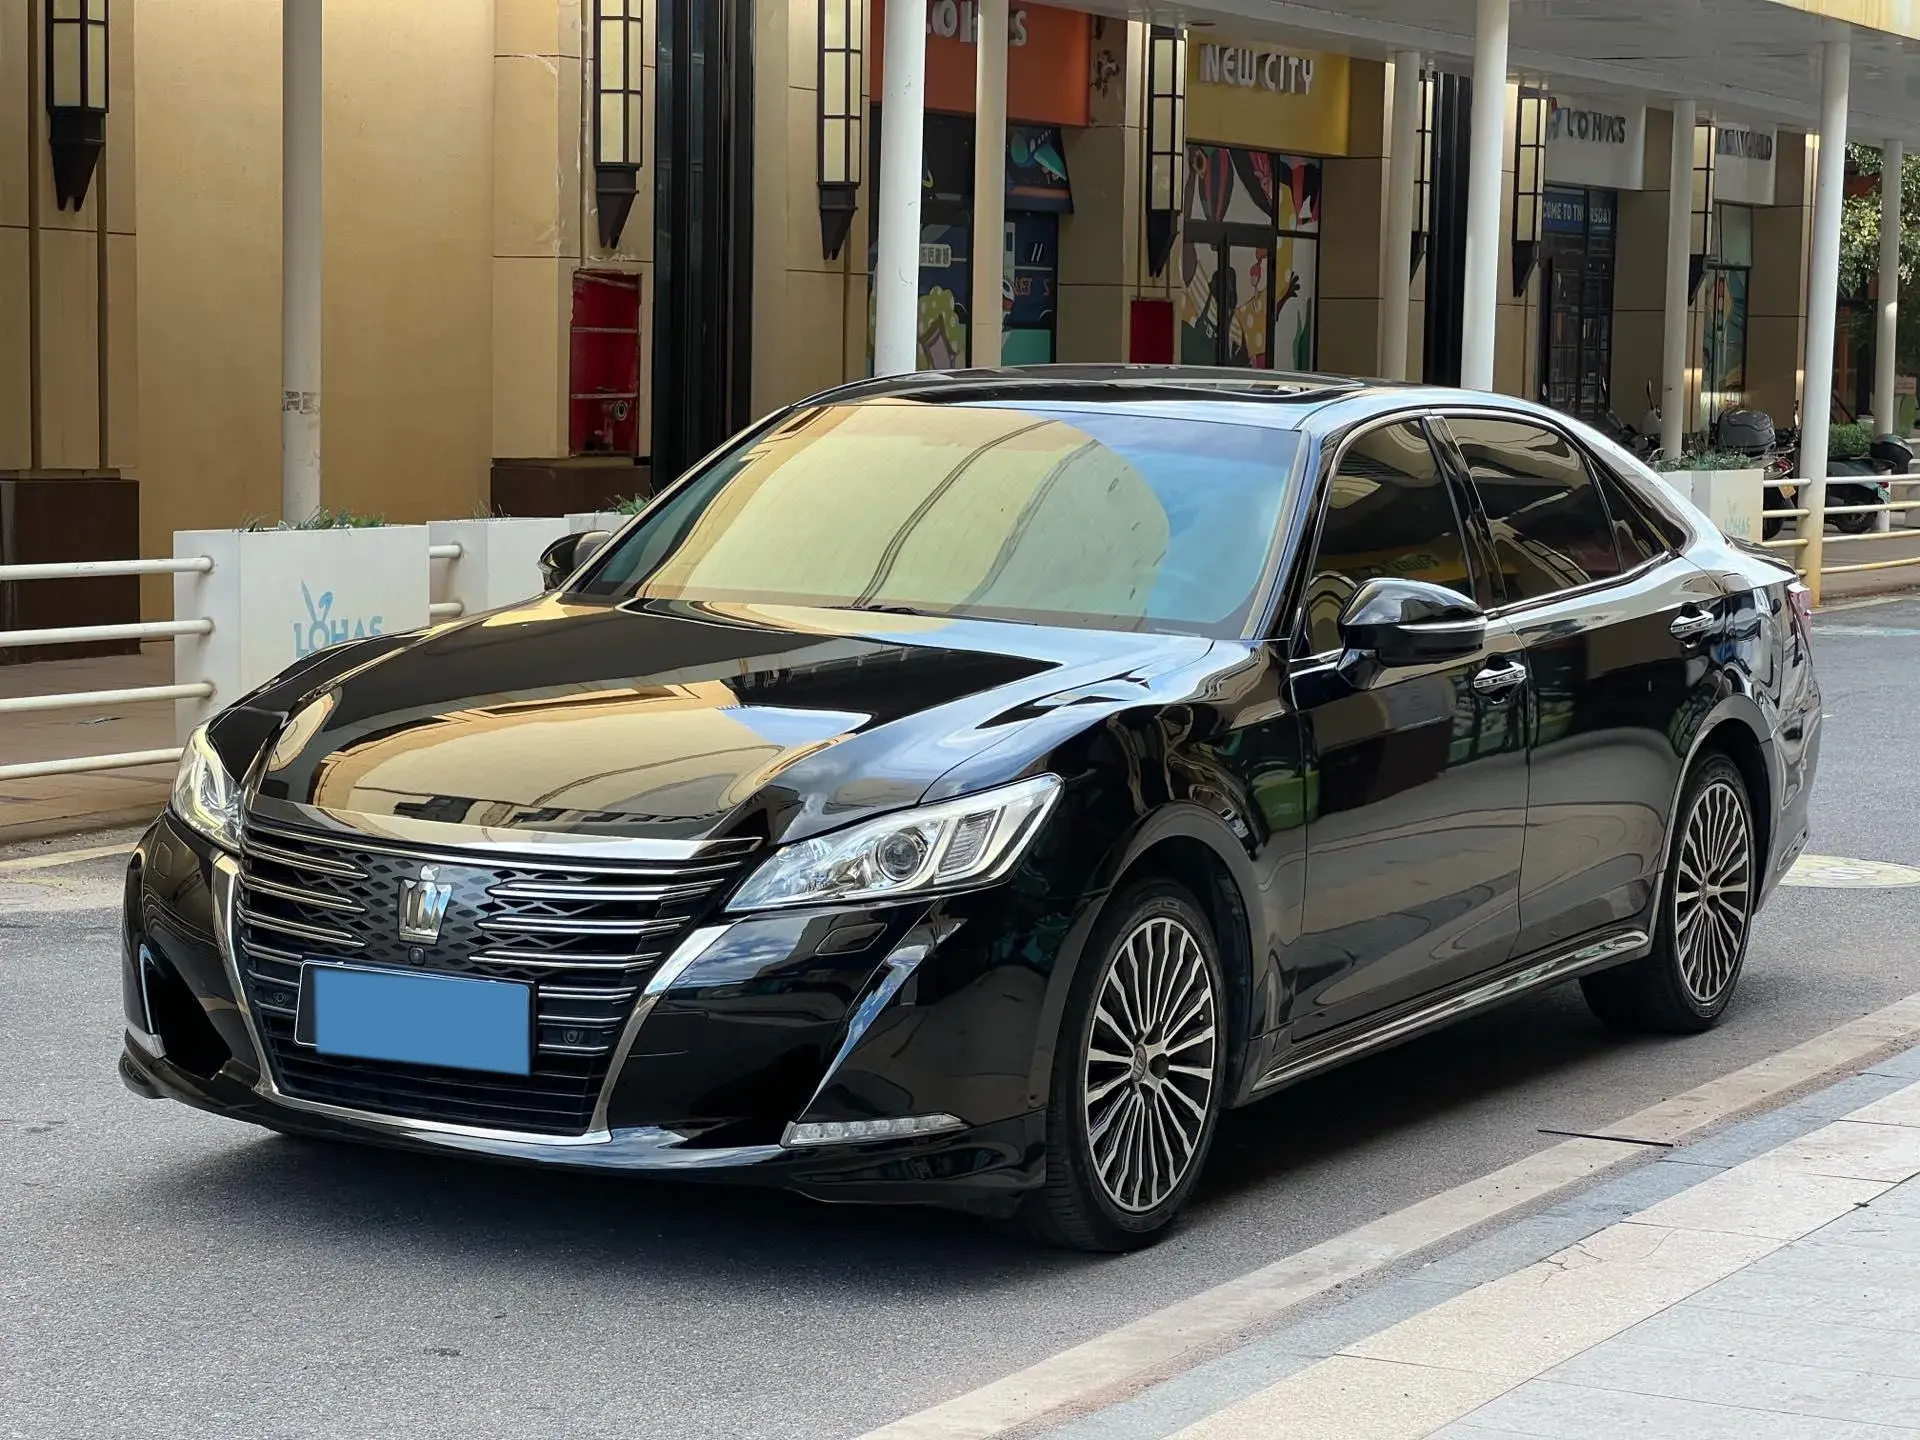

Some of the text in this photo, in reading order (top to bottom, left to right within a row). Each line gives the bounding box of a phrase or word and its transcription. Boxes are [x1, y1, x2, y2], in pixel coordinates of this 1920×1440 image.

[926, 0, 1027, 46] OHS
[1200, 44, 1314, 96] NEW CITY
[1724, 516, 1751, 536] LOHAS
[293, 615, 383, 658] LOHAS
